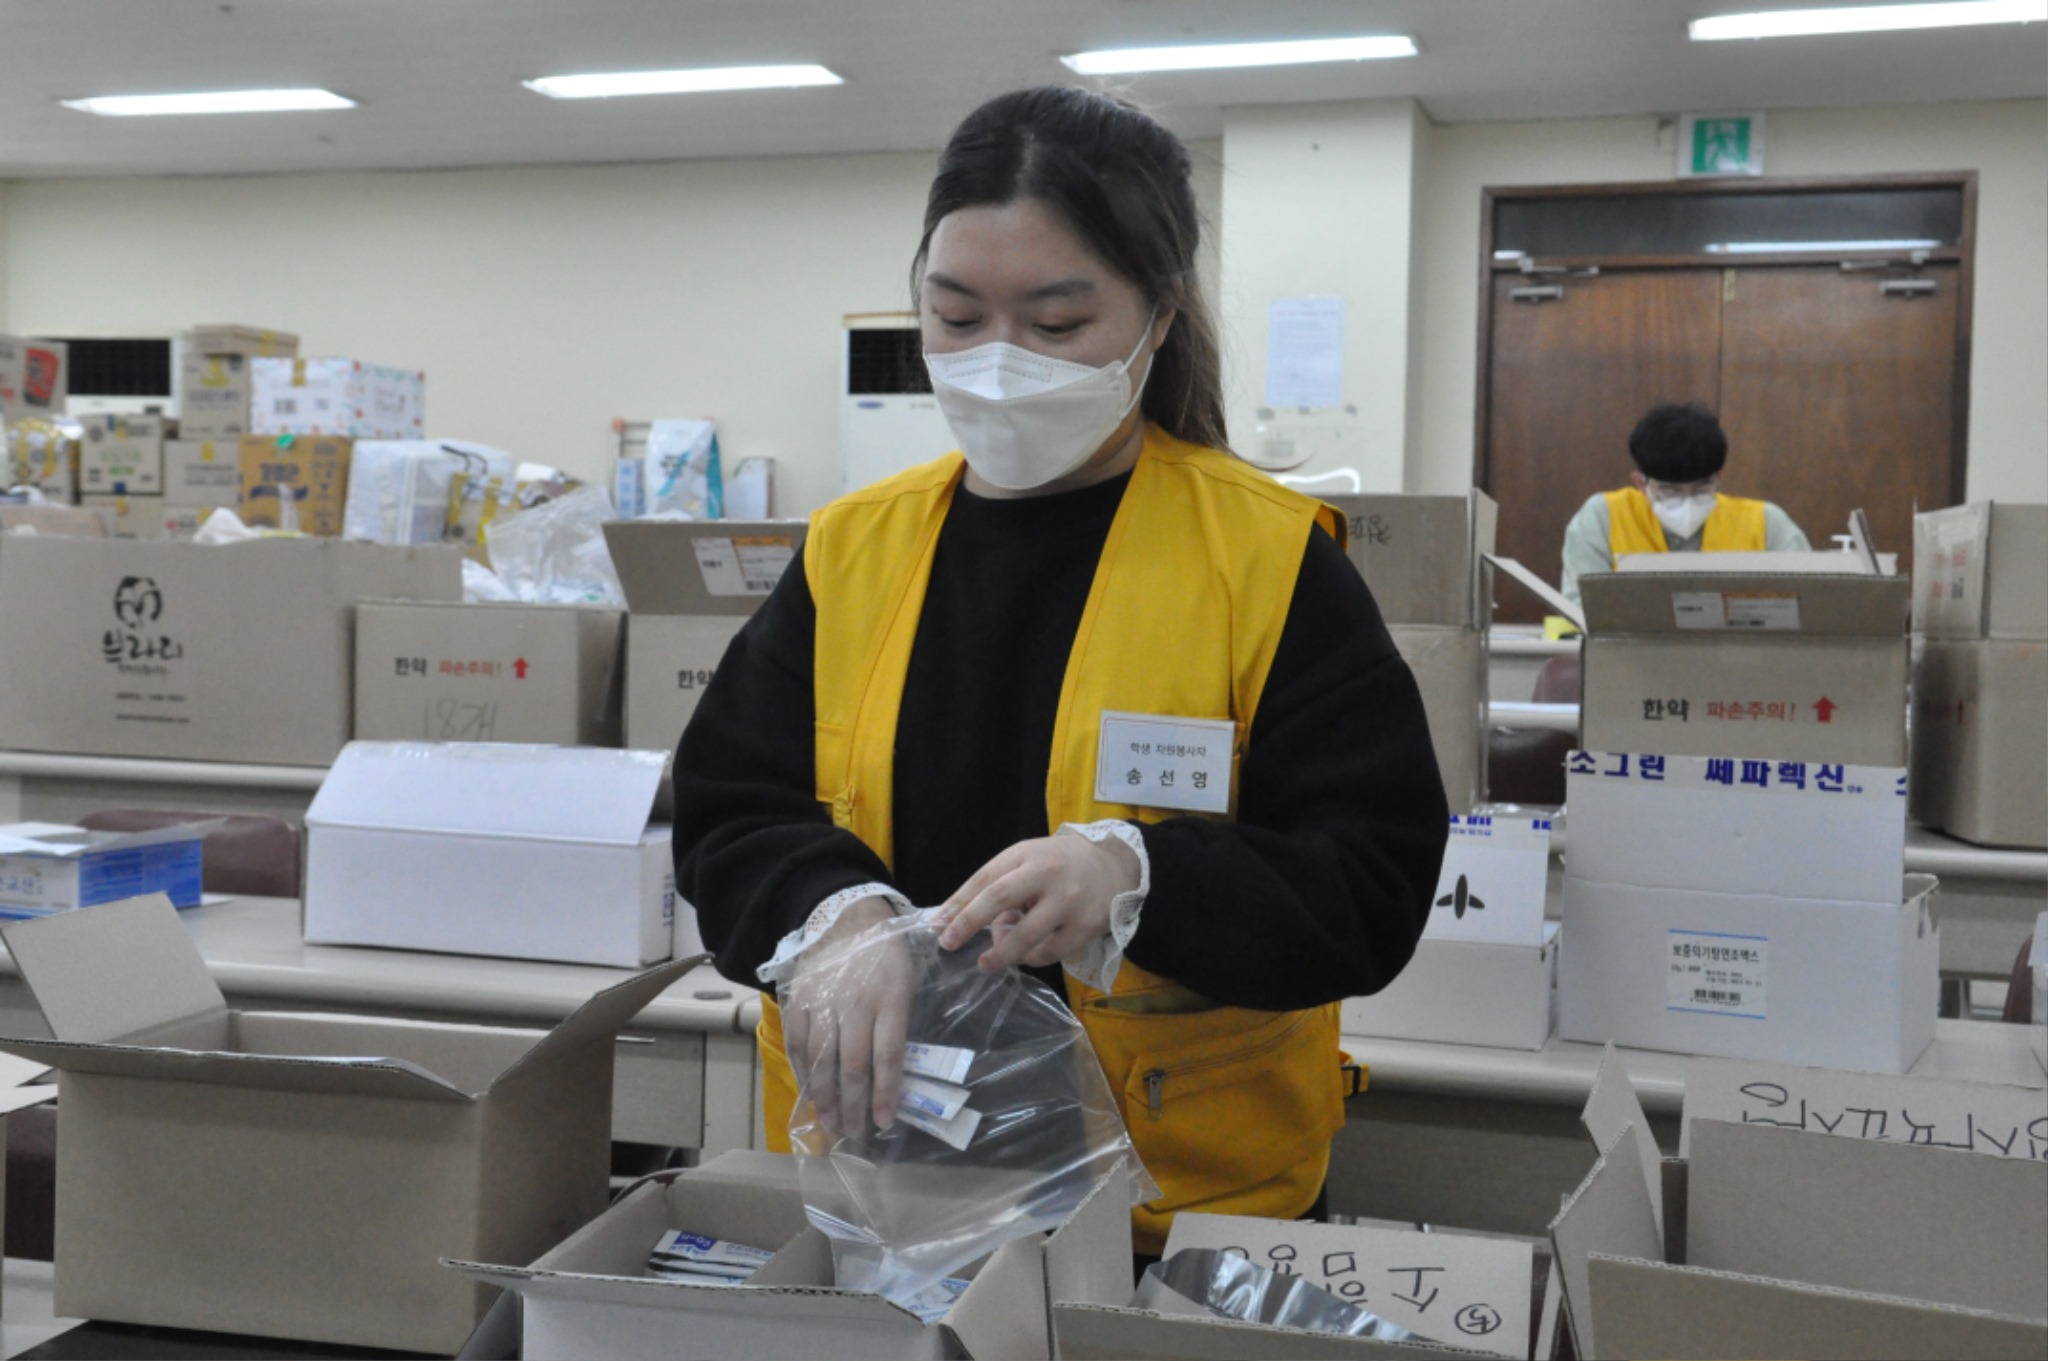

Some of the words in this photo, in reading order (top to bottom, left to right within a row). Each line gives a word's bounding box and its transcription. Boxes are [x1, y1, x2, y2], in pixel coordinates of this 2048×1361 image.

[395, 657, 427, 678] 한약
[1642, 698, 1689, 723] 한약
[1707, 700, 1797, 723] 파손주의!
[1130, 742, 1151, 756] 학생
[1155, 743, 1206, 757] 자원봉사자
[1126, 767, 1142, 786] 송
[1160, 769, 1174, 787] 선
[1192, 771, 1207, 790] 영
[1569, 751, 1666, 781] 소그린
[1704, 758, 1844, 793] 쎄파렉신
